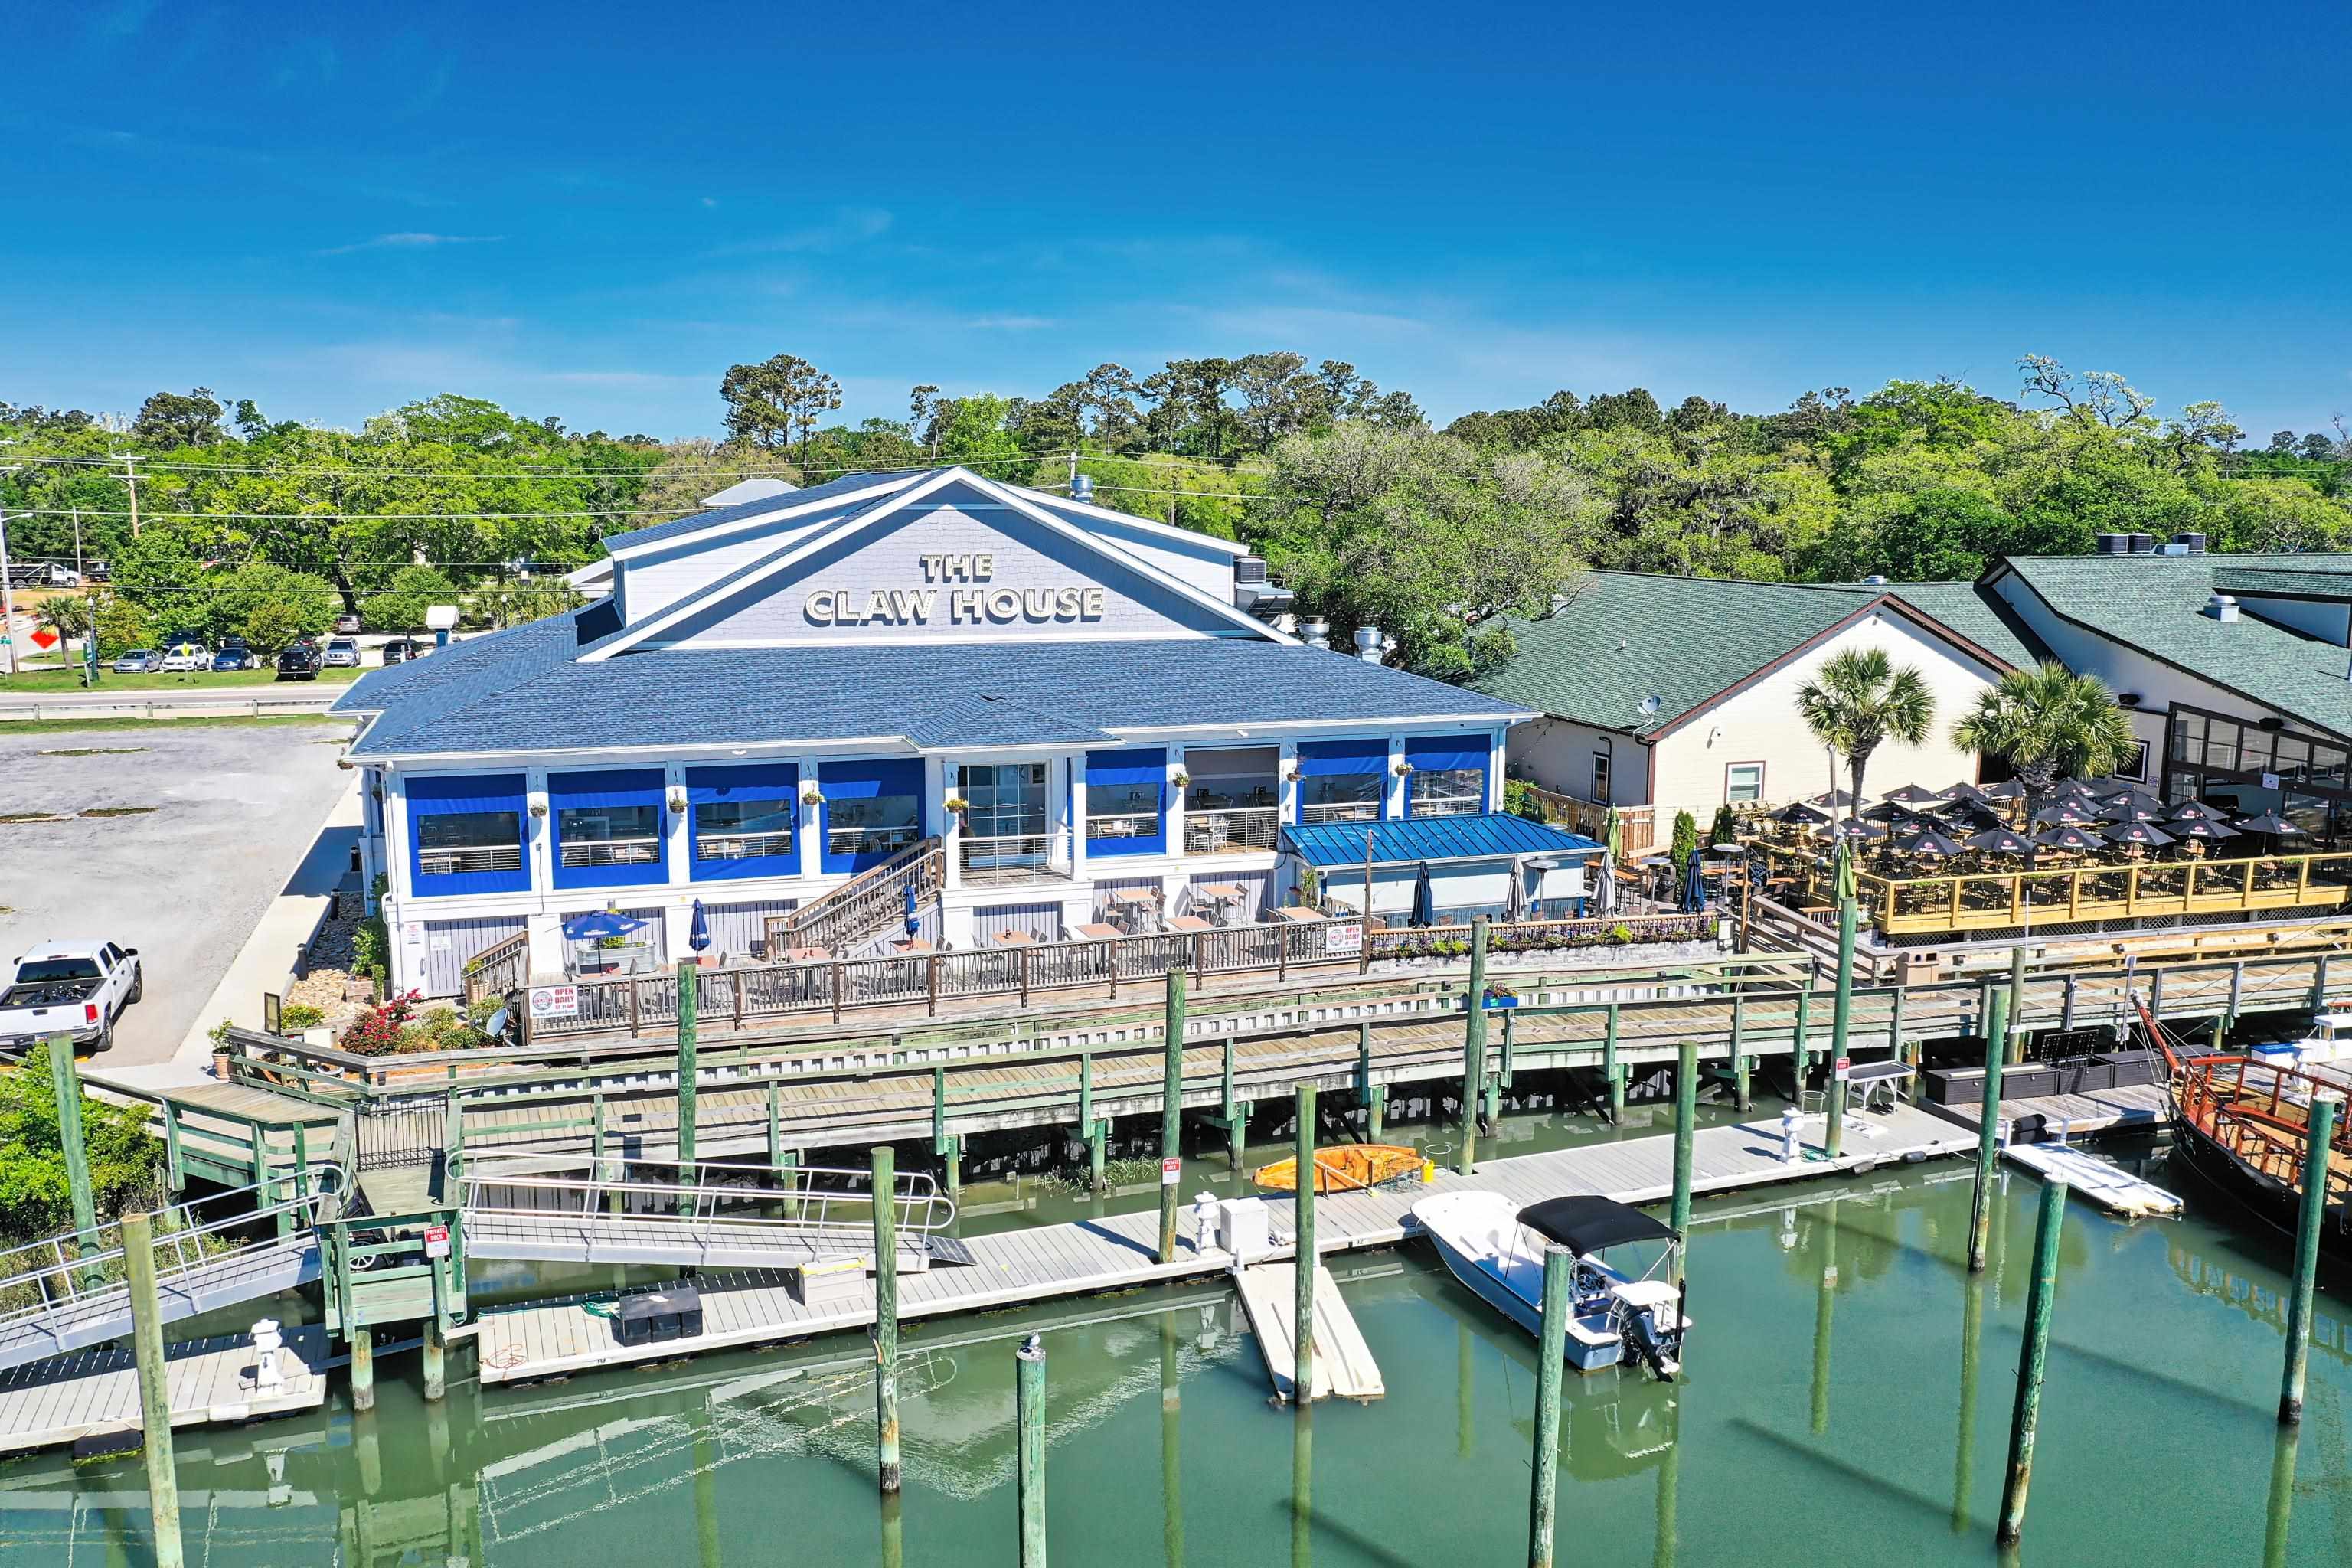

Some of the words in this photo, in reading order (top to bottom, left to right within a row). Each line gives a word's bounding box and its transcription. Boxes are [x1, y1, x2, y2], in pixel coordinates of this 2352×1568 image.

[920, 554, 993, 579] THE
[805, 589, 938, 622] CLAW
[951, 587, 1104, 620] HOUSE
[883, 1378, 894, 1396] 8
